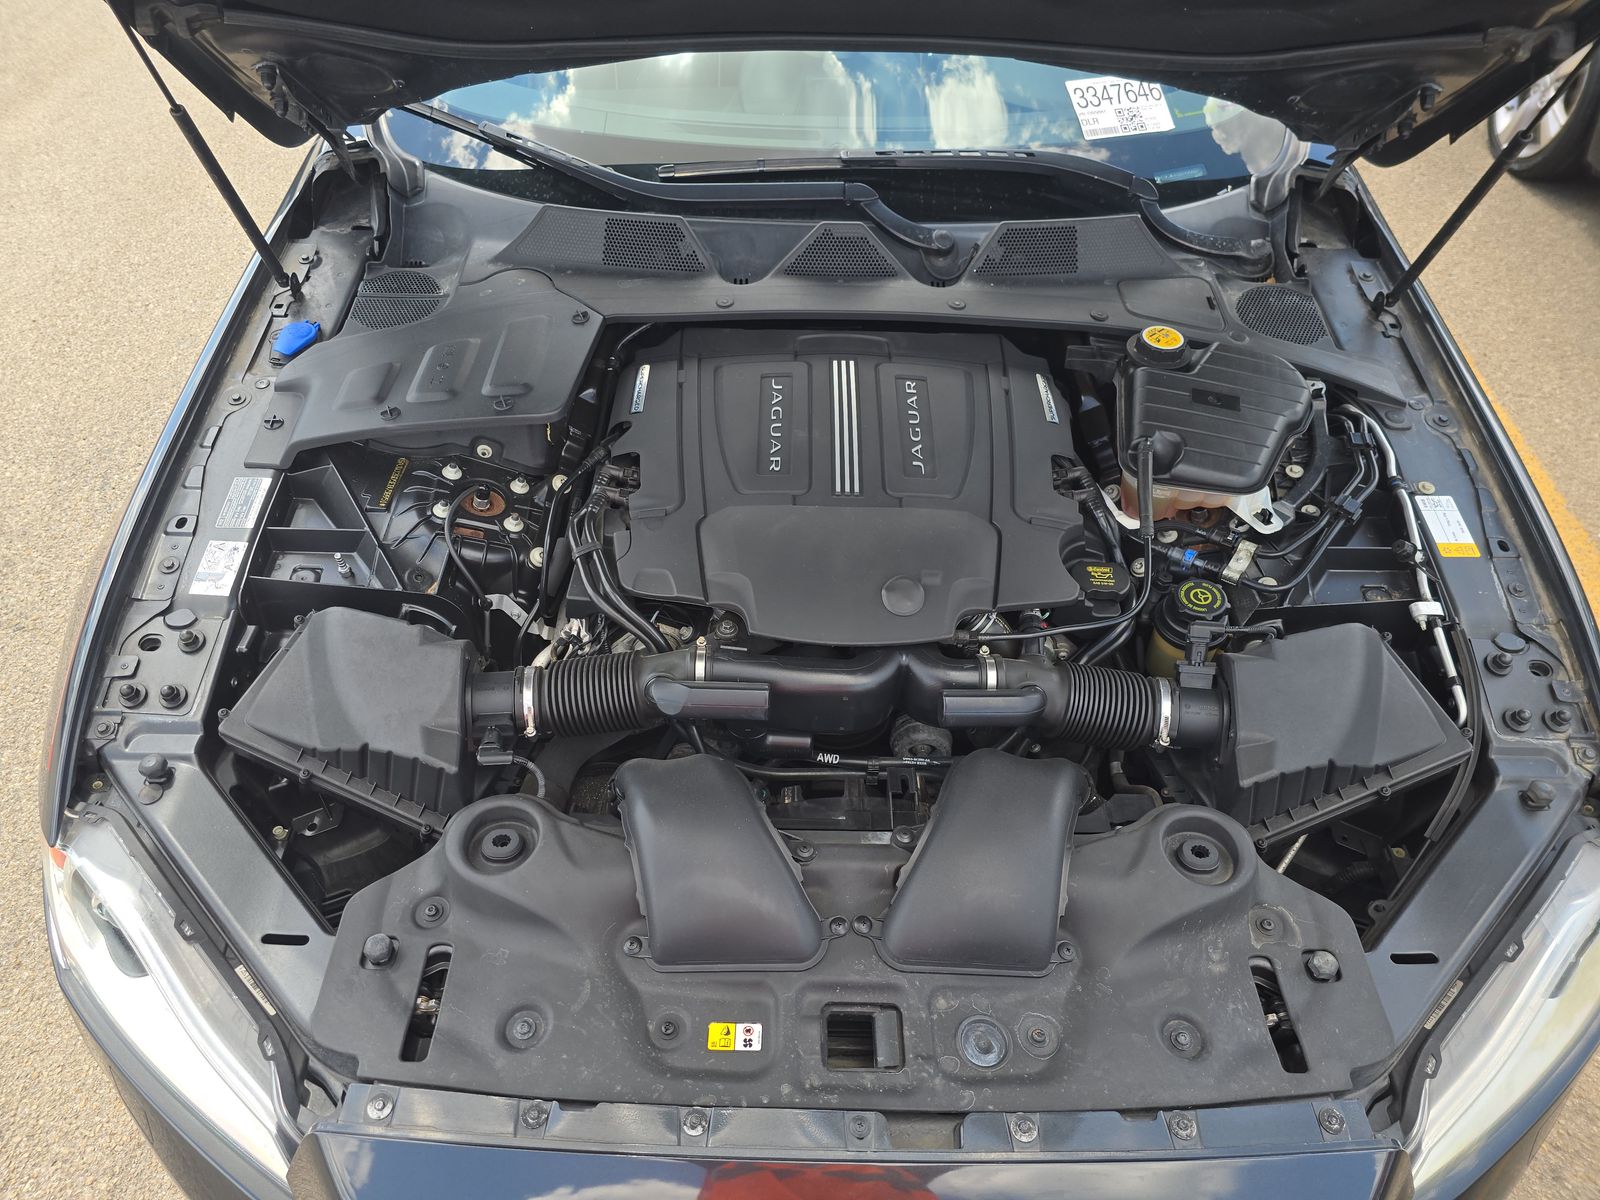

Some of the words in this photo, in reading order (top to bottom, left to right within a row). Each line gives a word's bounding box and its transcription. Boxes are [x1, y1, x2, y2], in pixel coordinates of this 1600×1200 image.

[1074, 82, 1162, 109] 3347646
[769, 378, 783, 472] JAGUAR
[905, 380, 925, 475] JAGUAR
[816, 752, 840, 764] AWD
